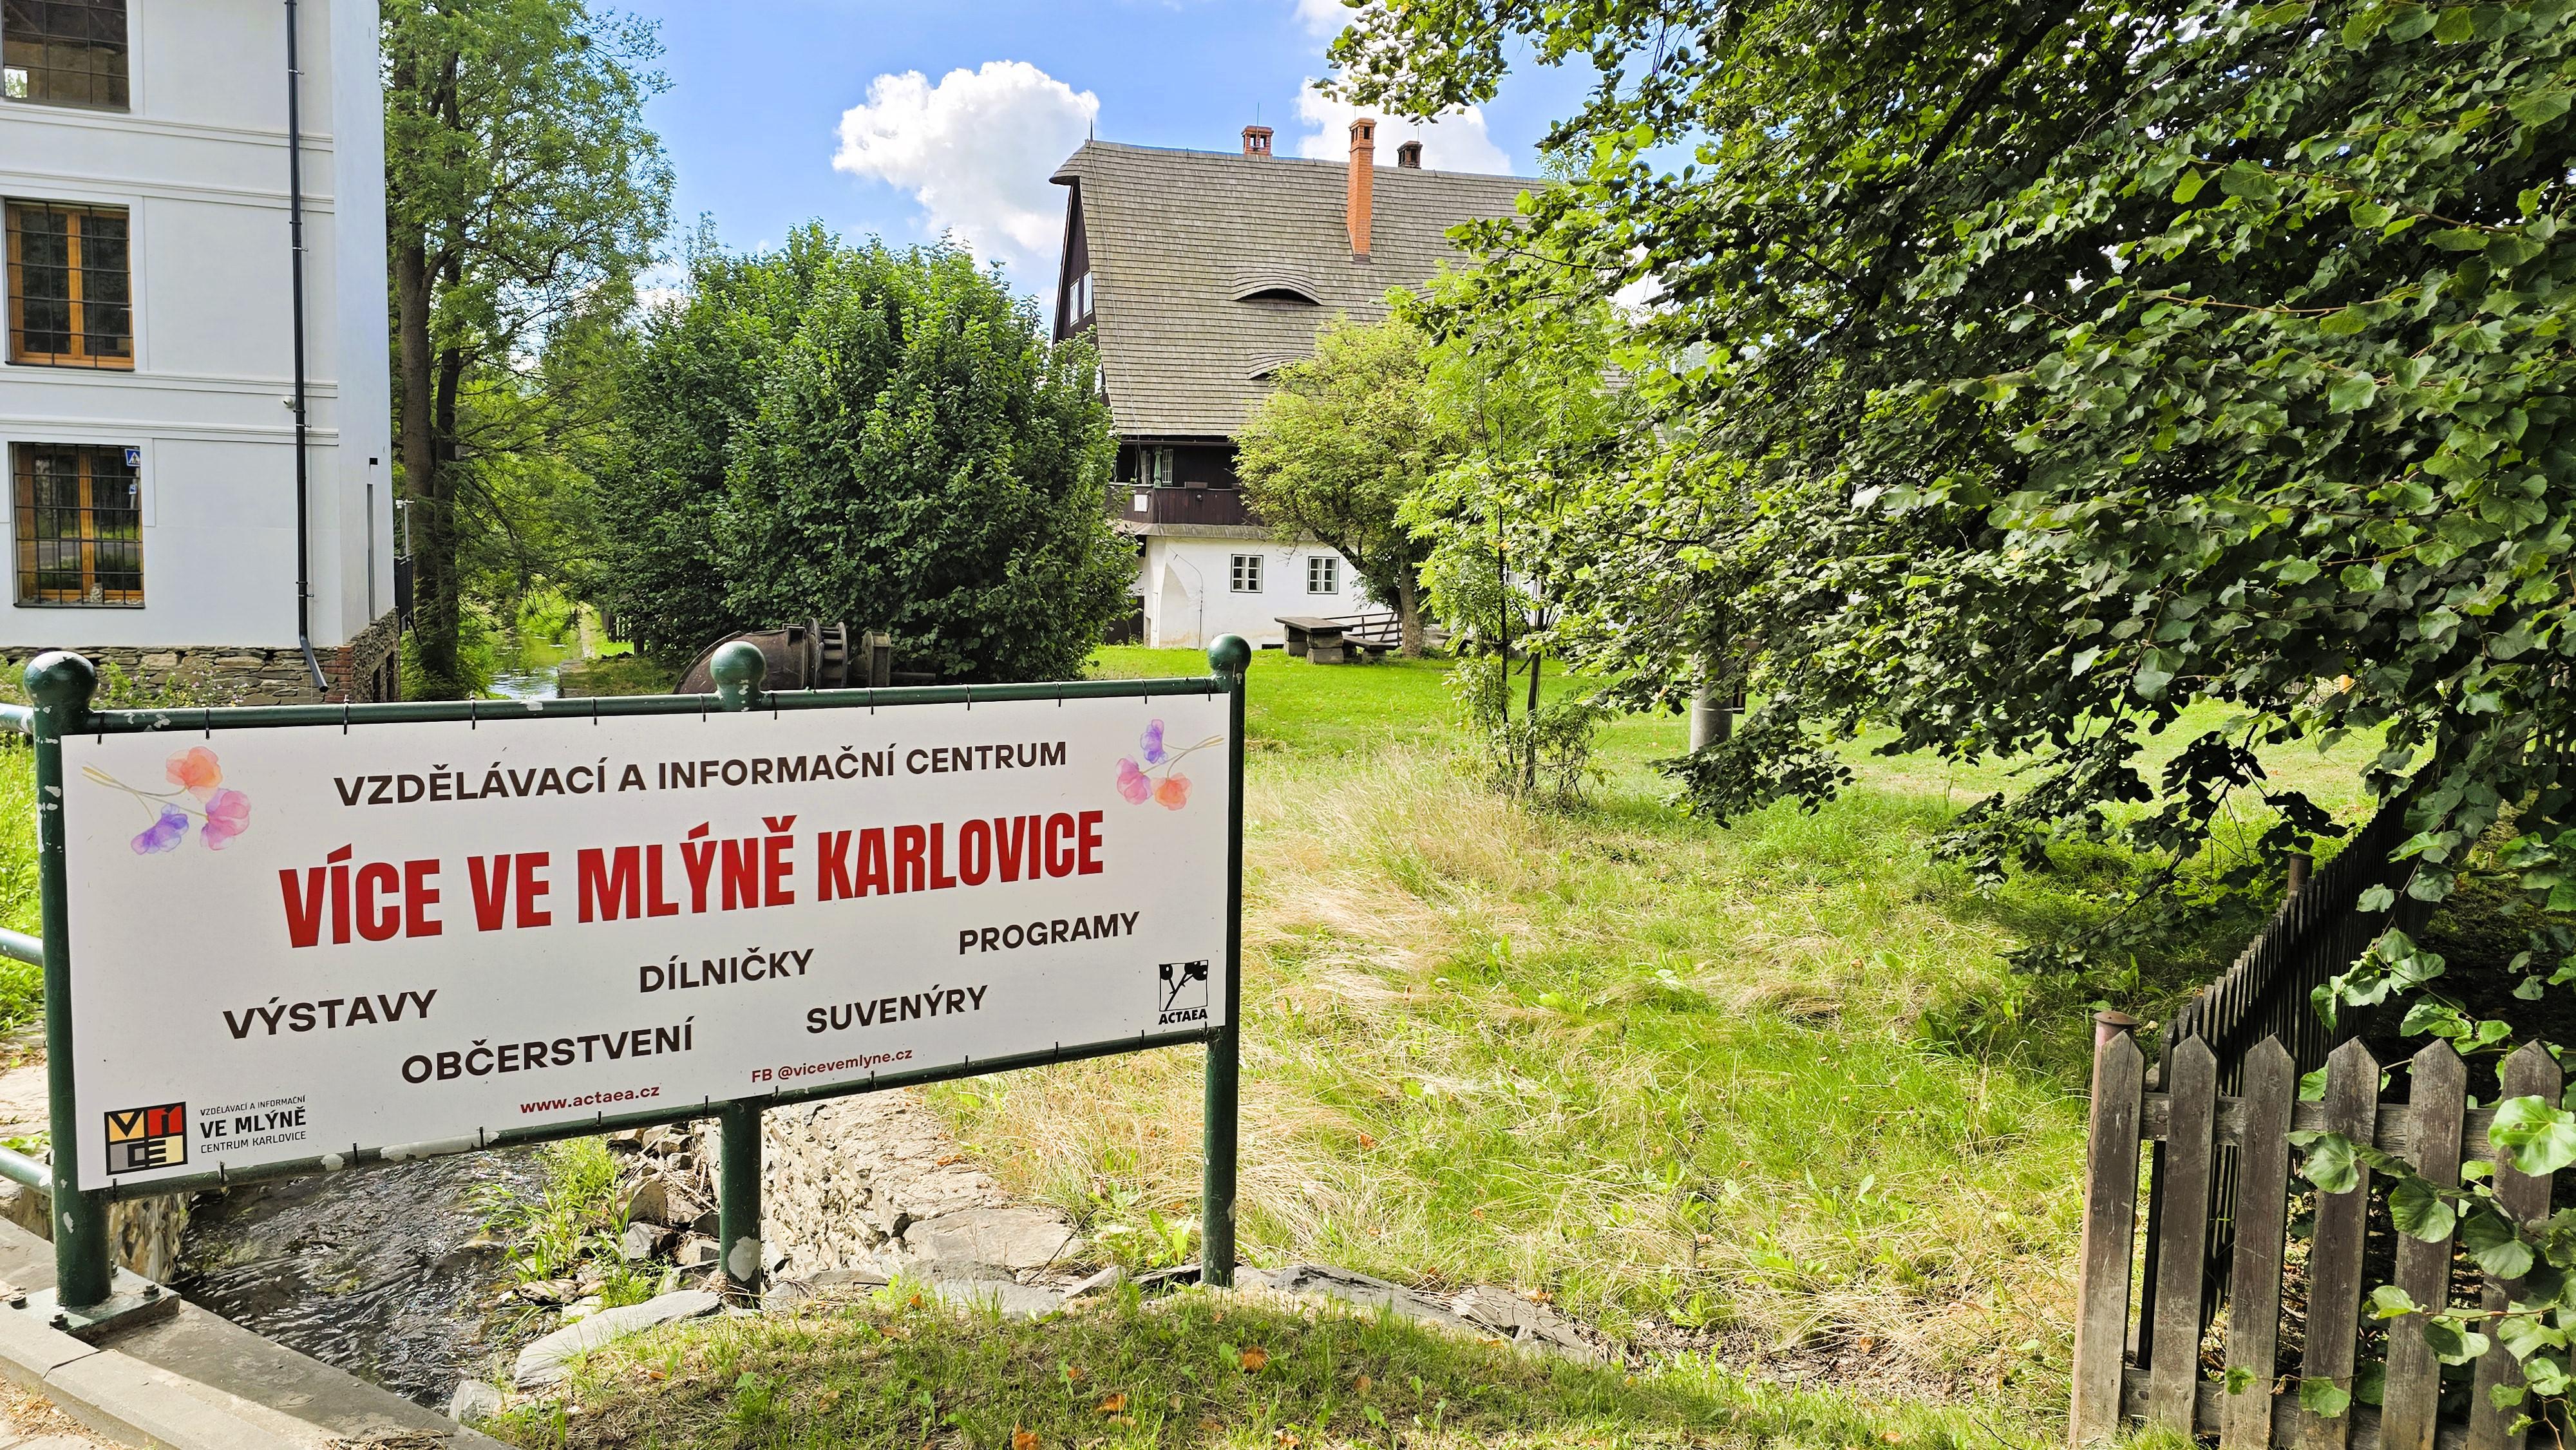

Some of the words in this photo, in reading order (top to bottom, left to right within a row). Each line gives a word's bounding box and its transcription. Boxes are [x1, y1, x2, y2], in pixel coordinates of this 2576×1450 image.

[334, 757, 609, 807] VZDĚLÁVACÍ
[618, 764, 647, 792] A
[659, 743, 897, 789] INFORMAČNÍ
[907, 741, 1066, 775] CENTRUM
[279, 843, 442, 948] VÍCE
[467, 851, 552, 932] VE
[578, 814, 798, 924] MLÝNĚ
[817, 810, 1103, 902] KARLOVICE
[959, 910, 1140, 956] PROGRAMY
[639, 947, 815, 993] DÍLNIČKY
[222, 988, 438, 1039] VÝSTAVY
[806, 984, 989, 1035] SUVENÝRY
[1158, 1008, 1209, 1026] ACTAEA
[401, 1016, 695, 1084] OBČERSTVENÍ
[752, 1069, 773, 1084] FB
[777, 1048, 913, 1081] @vicevemlyne.cz
[200, 1119, 227, 1139] VE
[234, 1106, 307, 1135] MLÝNĚ
[520, 1086, 660, 1114] www.actaea.cz
[201, 1138, 249, 1154] CENTRUM
[252, 1131, 307, 1147] KARLOVICE
